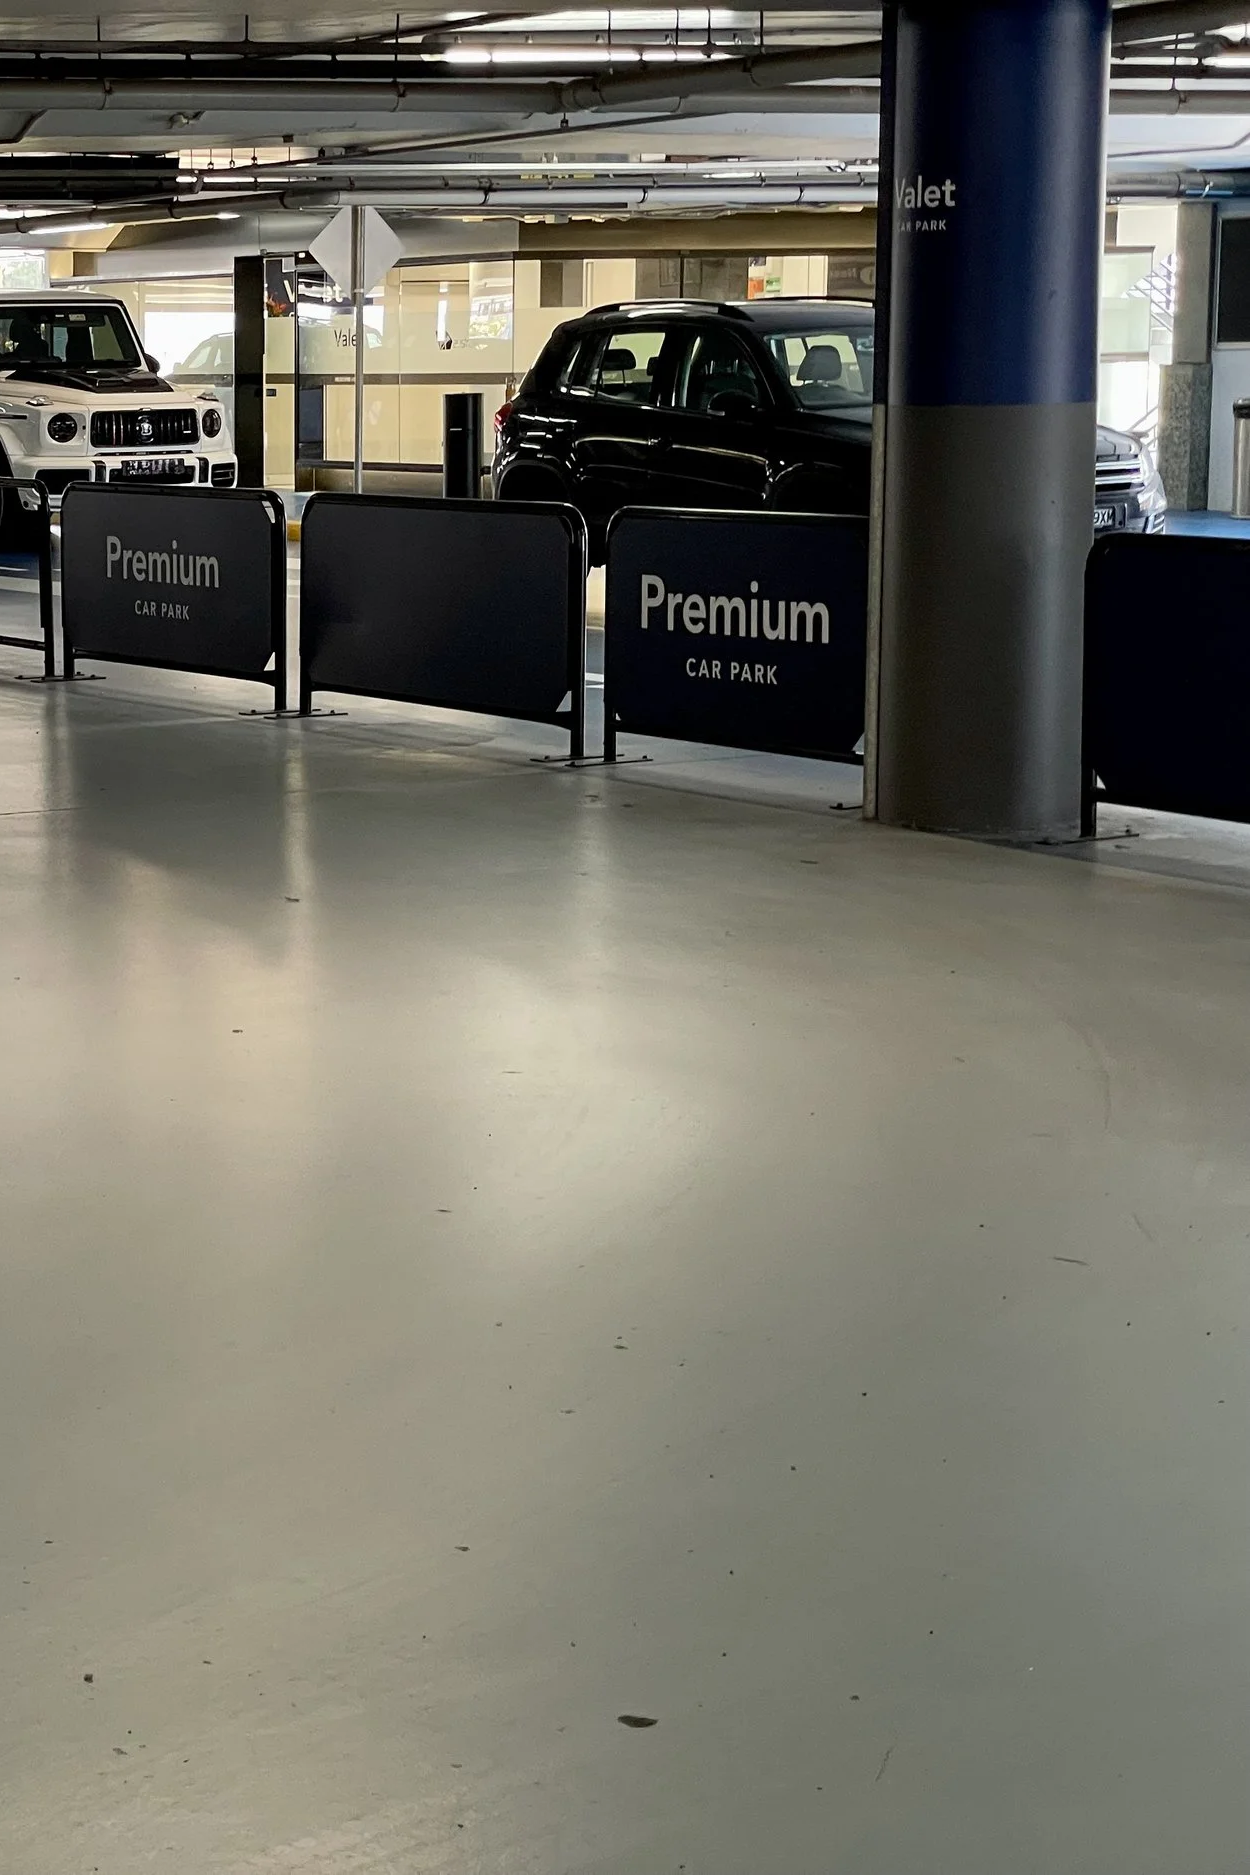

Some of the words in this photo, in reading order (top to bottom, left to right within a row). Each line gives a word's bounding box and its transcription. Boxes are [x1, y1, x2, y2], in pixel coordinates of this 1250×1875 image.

[894, 174, 956, 208] Valet
[915, 220, 946, 231] PARK
[334, 328, 357, 347] Vale
[106, 535, 220, 588] Premium
[134, 600, 157, 617] CAR
[161, 602, 190, 621] PARK
[640, 574, 830, 644] Premium
[686, 657, 722, 680] CAR
[730, 661, 778, 685] PARK
